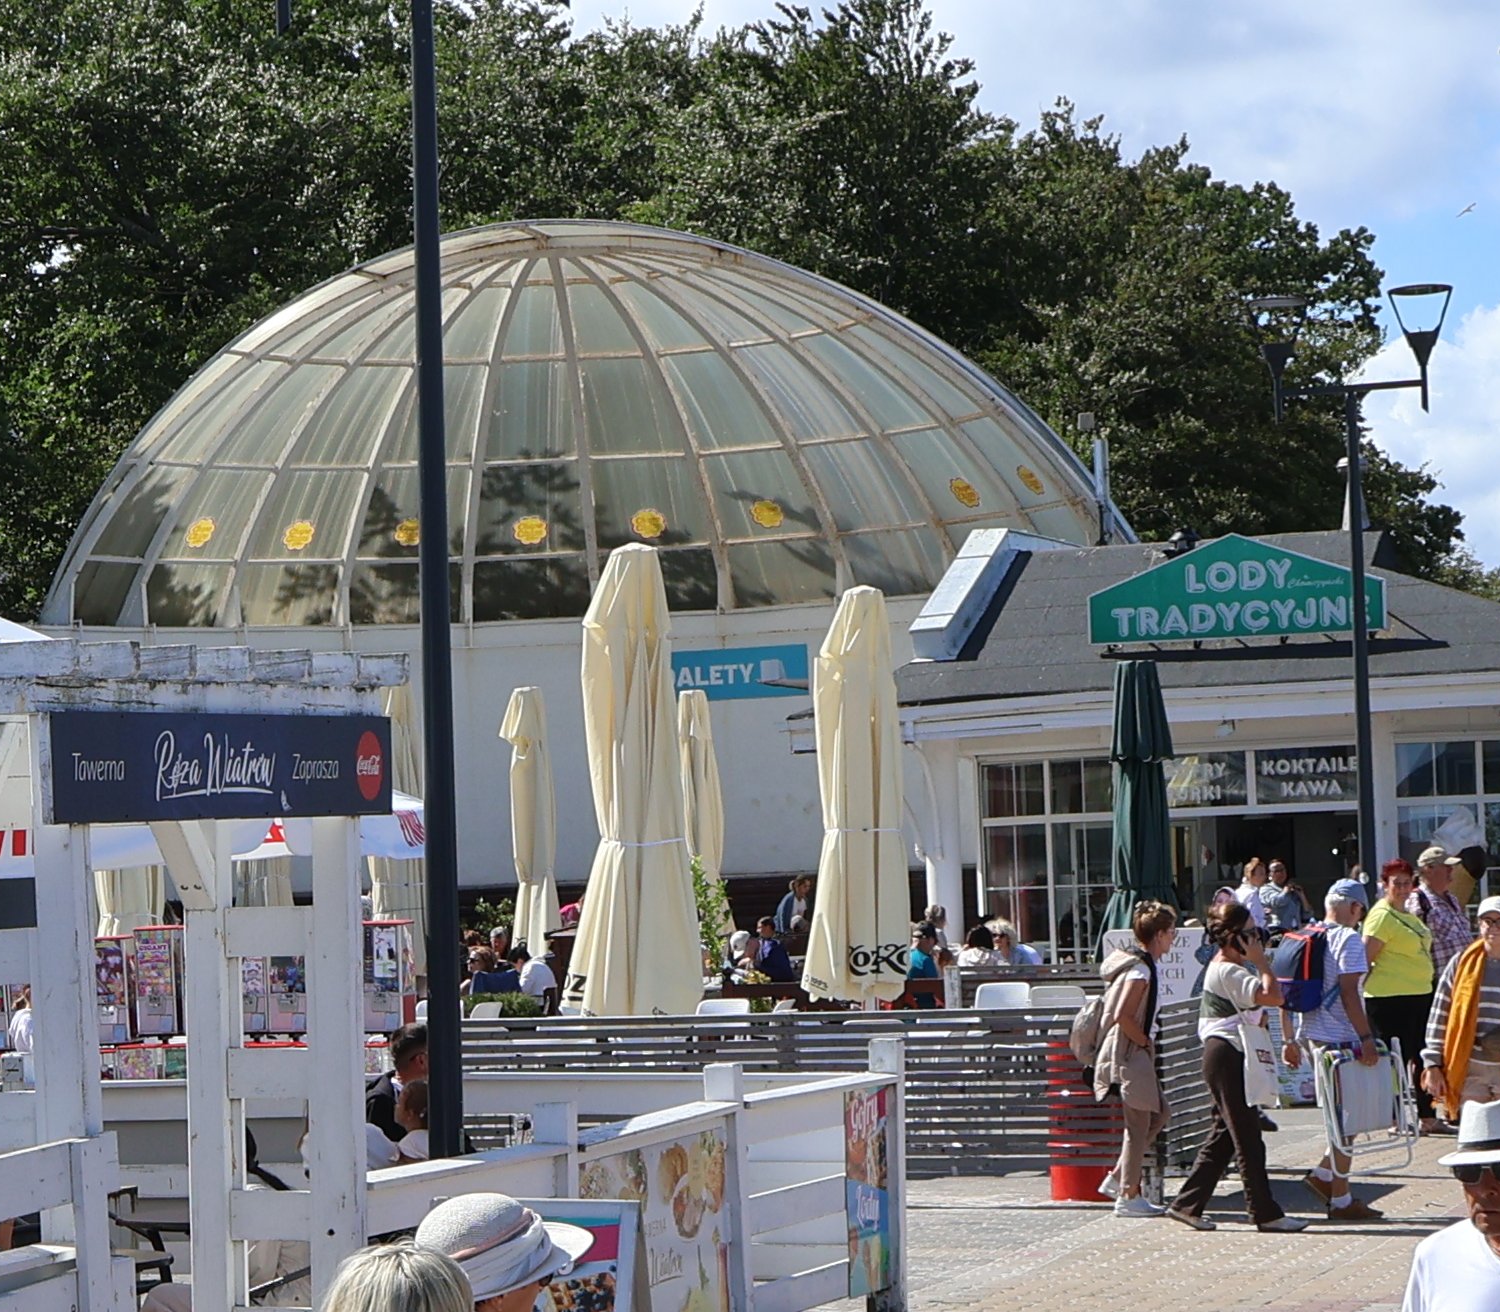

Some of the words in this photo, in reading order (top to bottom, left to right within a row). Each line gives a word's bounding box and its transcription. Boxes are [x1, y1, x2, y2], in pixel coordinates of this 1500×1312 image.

[1185, 558, 1292, 593] LODY
[673, 663, 754, 687] ALETY
[72, 753, 125, 781] Tawerna
[292, 753, 339, 785] Zaprasza
[1261, 756, 1359, 775] KOKTAILE
[1281, 779, 1343, 797] KAWA
[851, 1094, 878, 1143] Gofry
[856, 1185, 880, 1232] Lody
